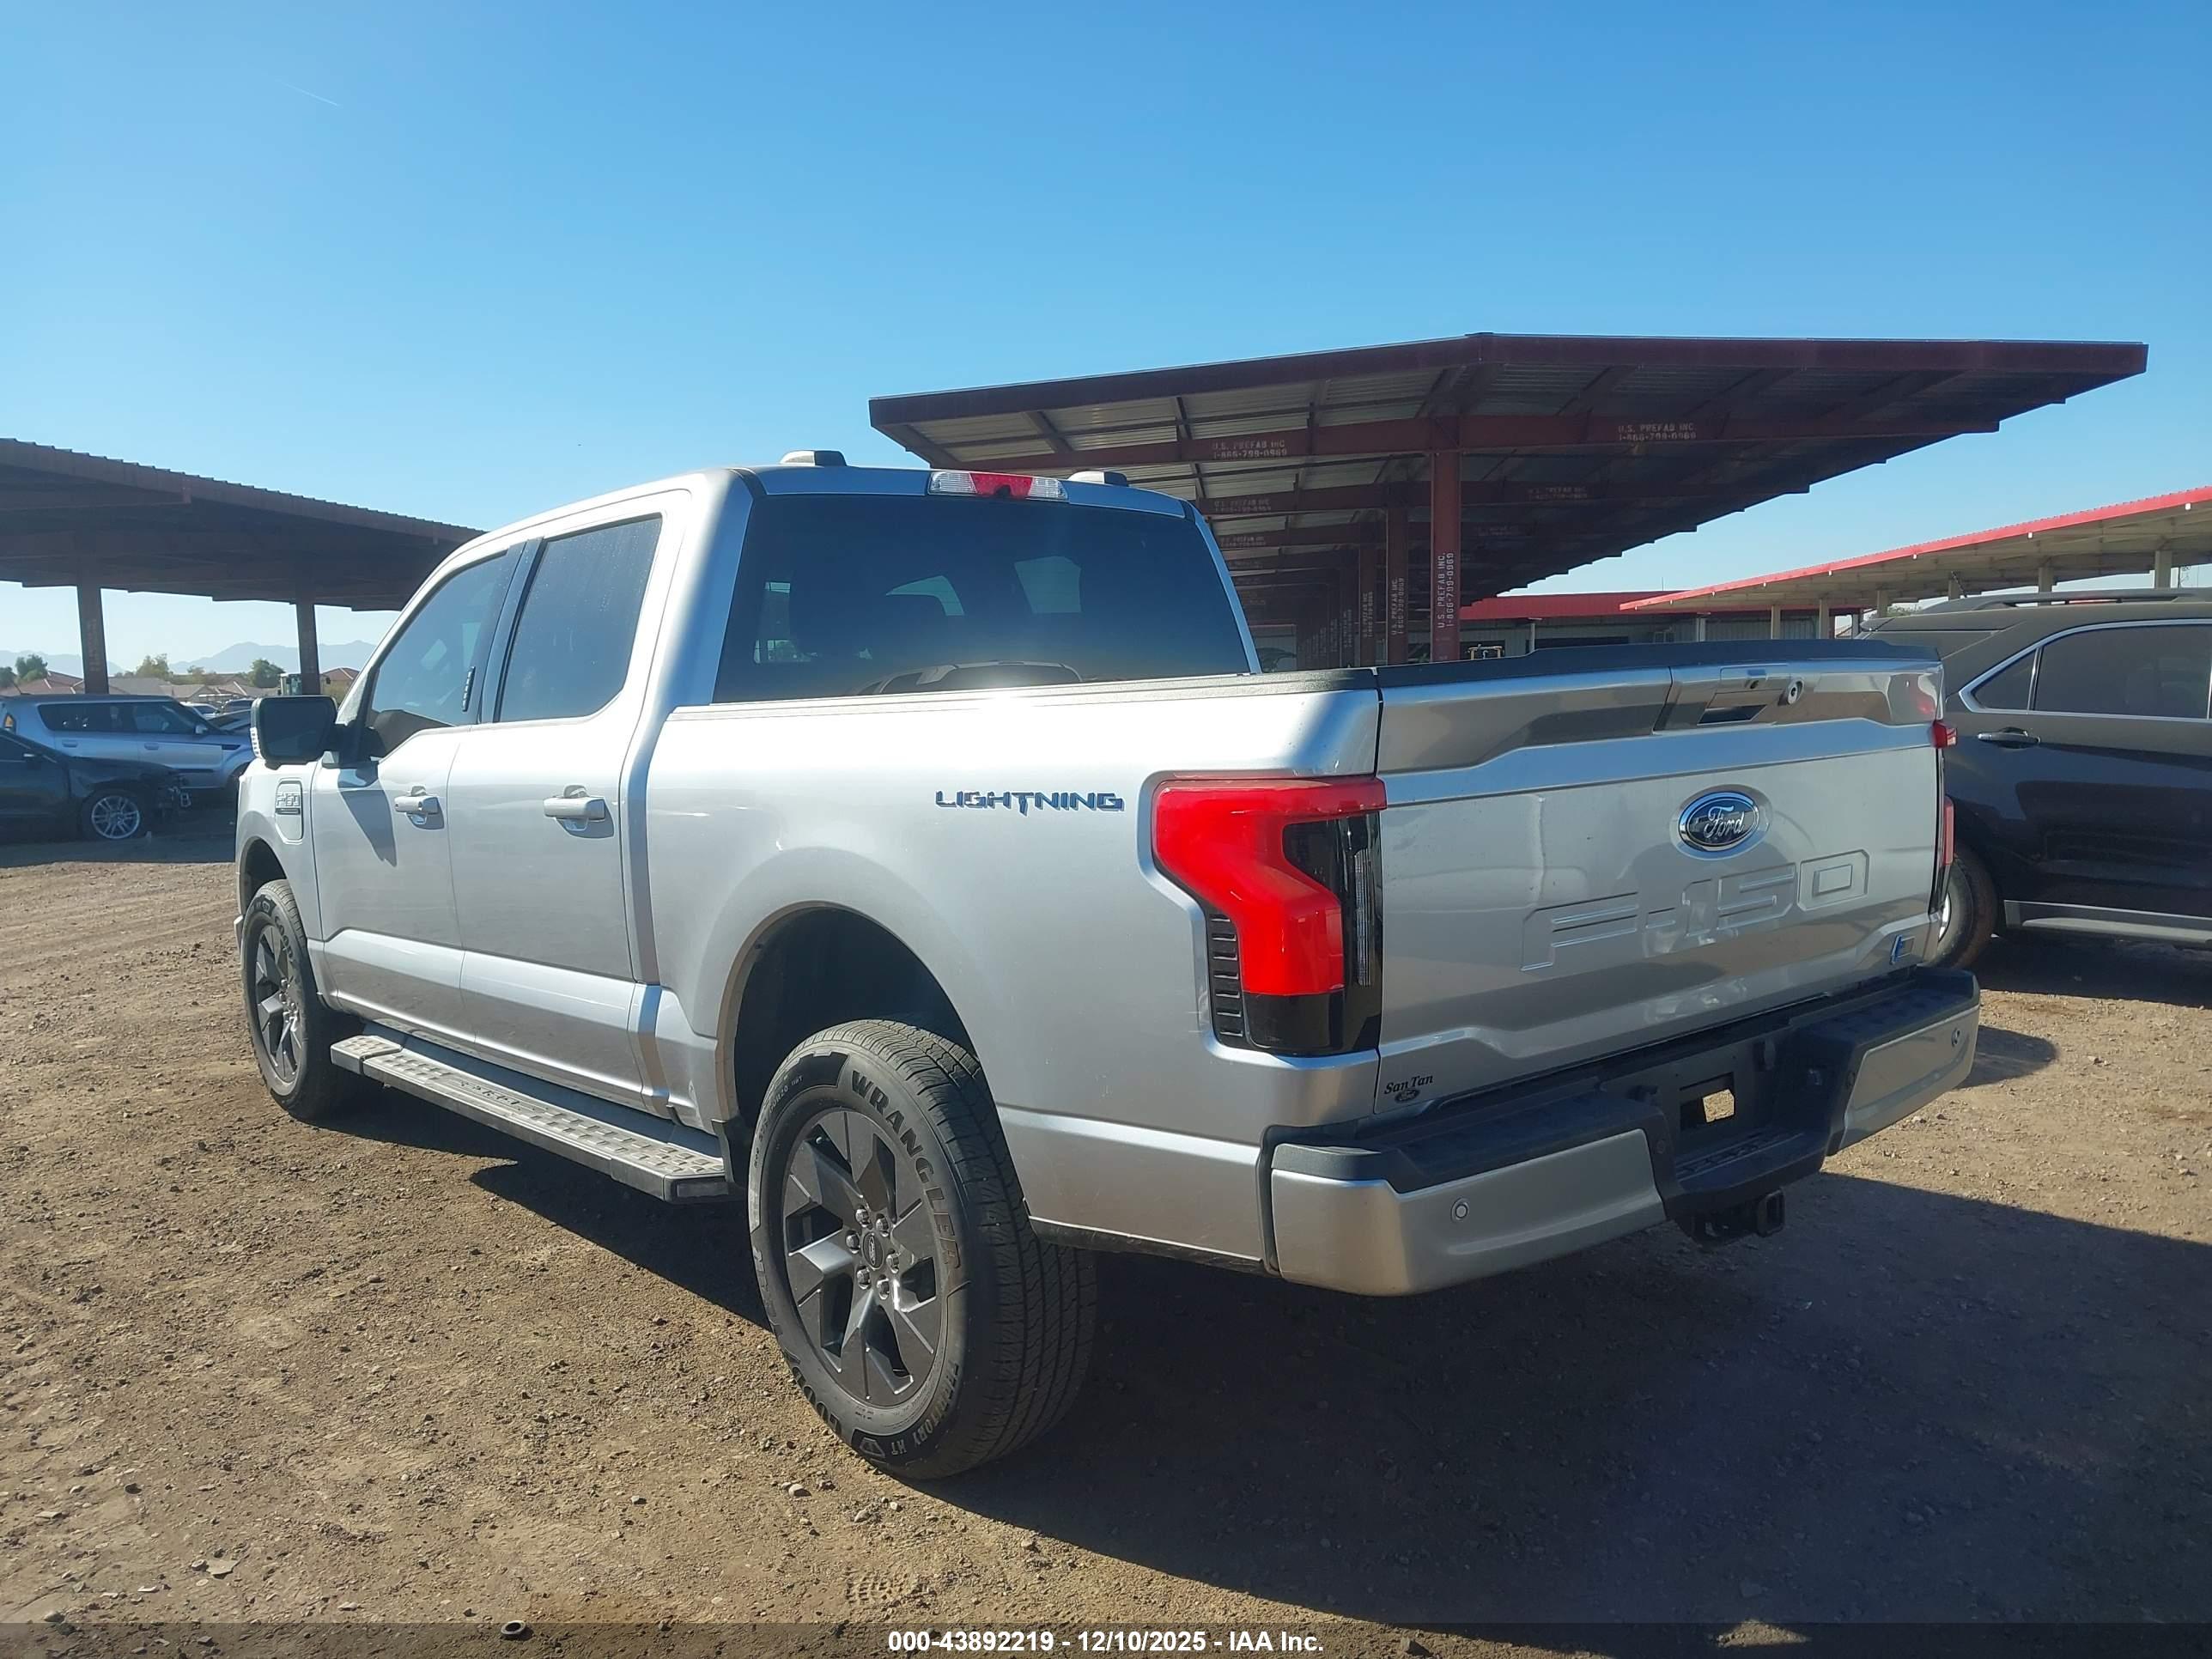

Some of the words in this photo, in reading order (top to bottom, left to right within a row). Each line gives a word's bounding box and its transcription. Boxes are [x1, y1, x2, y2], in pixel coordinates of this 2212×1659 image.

[1437, 573, 1445, 607] PREFAB
[1446, 552, 1455, 627] 1-866-799-0969
[935, 790, 1125, 817] LIGHTNING
[1704, 805, 1745, 838] Ford
[1521, 849, 1869, 971] F-150
[851, 1070, 961, 1269] WRANGLER
[890, 1438, 908, 1455] HT
